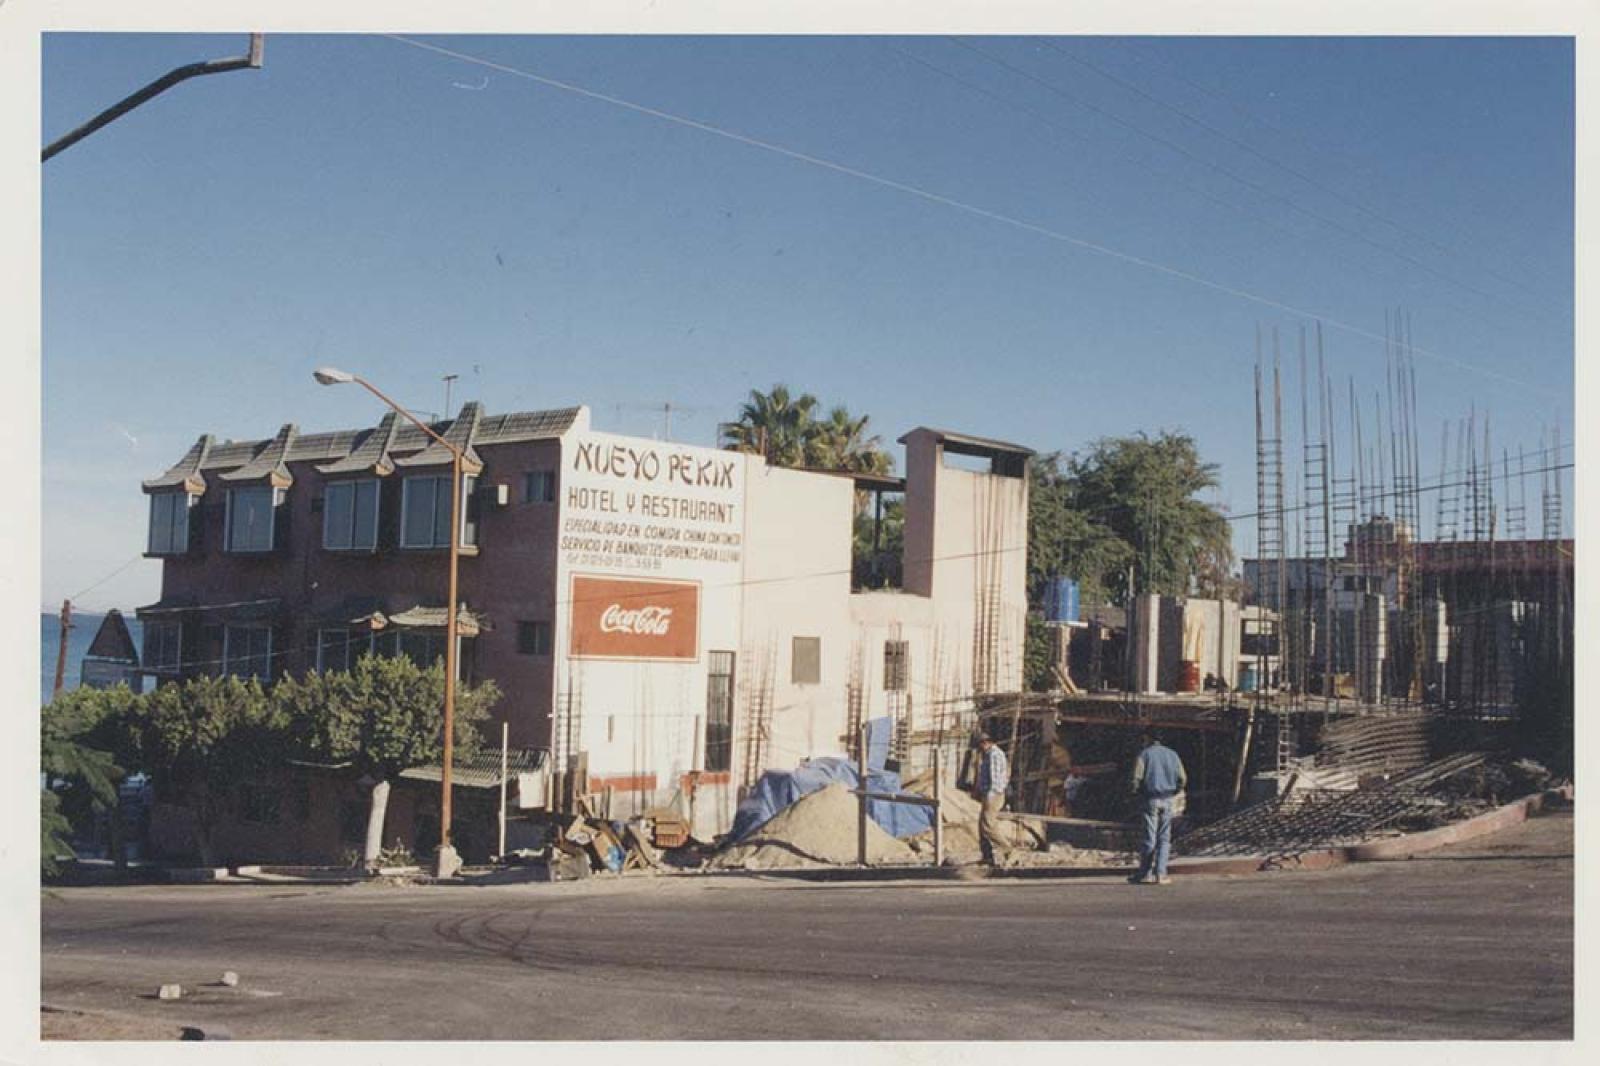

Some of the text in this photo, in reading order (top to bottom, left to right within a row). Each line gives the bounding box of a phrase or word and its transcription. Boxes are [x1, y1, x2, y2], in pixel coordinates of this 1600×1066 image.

[568, 486, 734, 523] HOTEL Y RESTAURANT
[627, 524, 641, 537] EN
[644, 525, 681, 541] COMIDA
[561, 536, 600, 552] SERVICIO
[602, 539, 614, 553] DE
